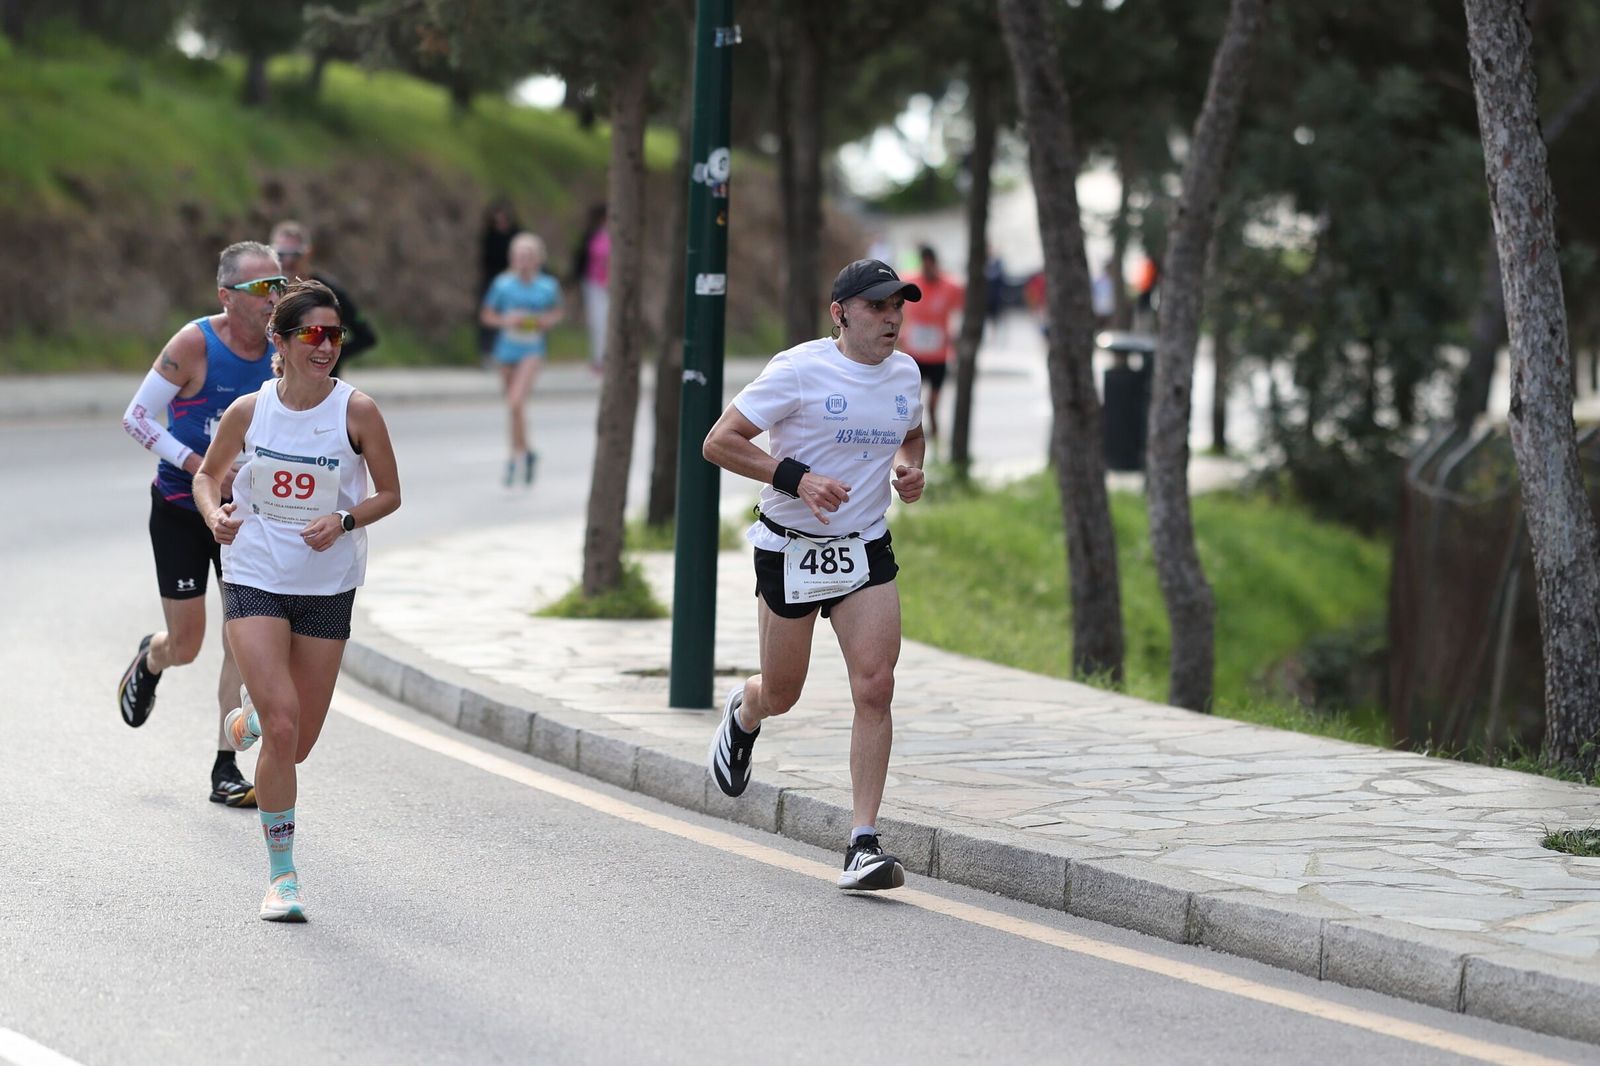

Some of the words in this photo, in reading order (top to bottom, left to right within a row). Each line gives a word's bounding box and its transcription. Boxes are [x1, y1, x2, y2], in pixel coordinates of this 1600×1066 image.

[831, 398, 842, 408] FIAT
[835, 429, 853, 443] 43
[854, 428, 869, 436] Mini
[852, 436, 870, 444] Peña
[871, 436, 878, 444] El
[271, 470, 316, 500] 89
[799, 546, 855, 575] 485
